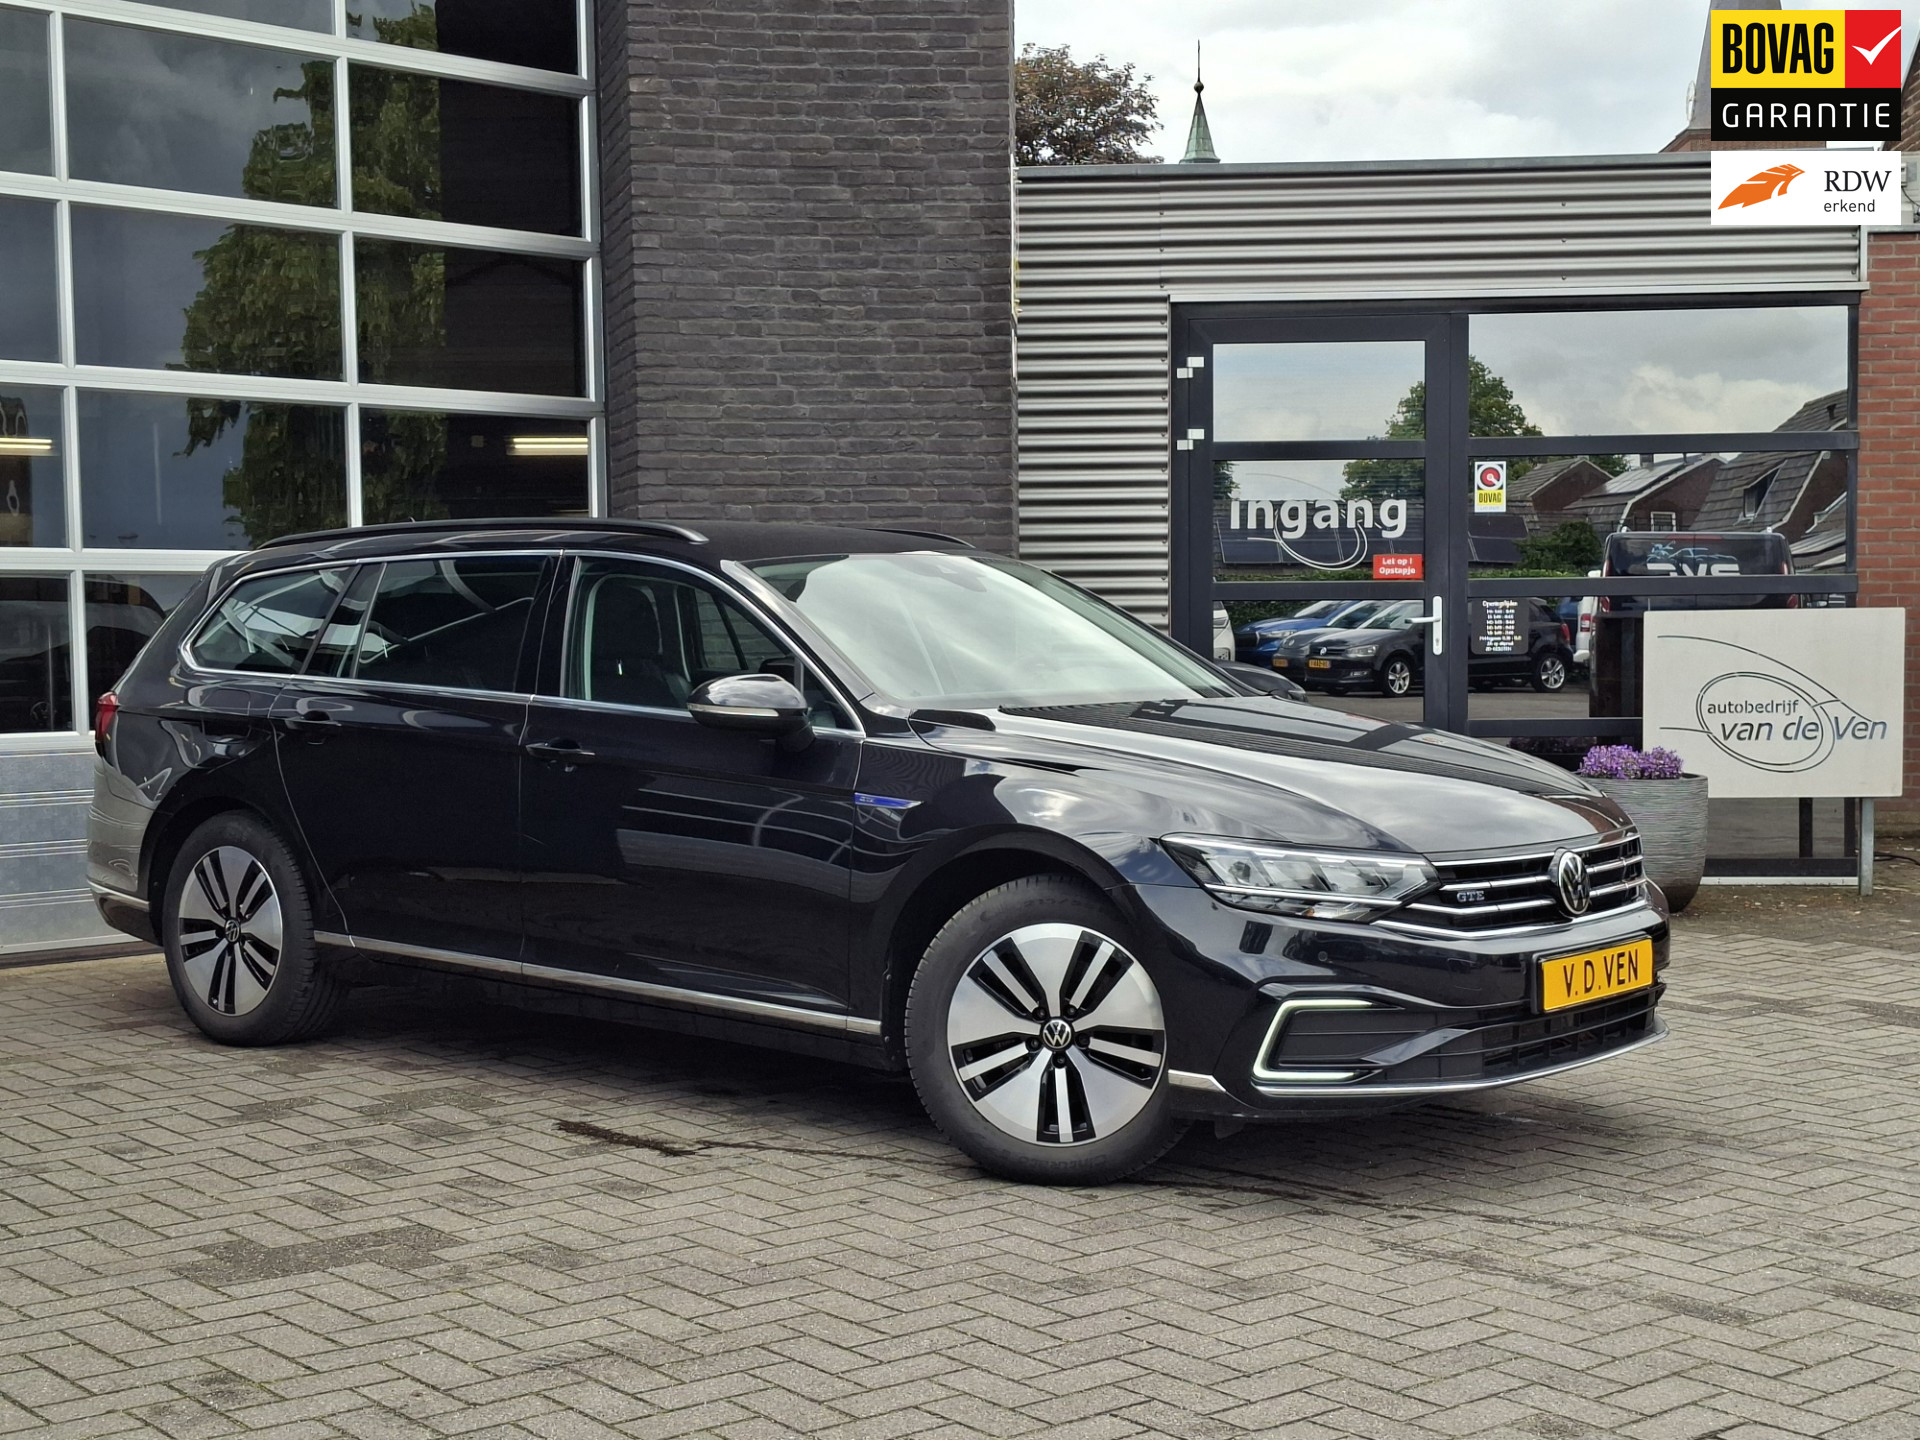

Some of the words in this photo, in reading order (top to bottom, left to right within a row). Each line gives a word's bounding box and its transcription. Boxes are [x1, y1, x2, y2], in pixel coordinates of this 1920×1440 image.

[1382, 557, 1395, 565] Let
[1397, 558, 1408, 566] op
[1379, 566, 1416, 576] Opstapje
[1707, 700, 1799, 716] autobedrijf
[1720, 722, 1773, 741] van
[1782, 715, 1820, 741] de
[1833, 715, 1888, 741] Ven
[1456, 889, 1485, 903] GTE
